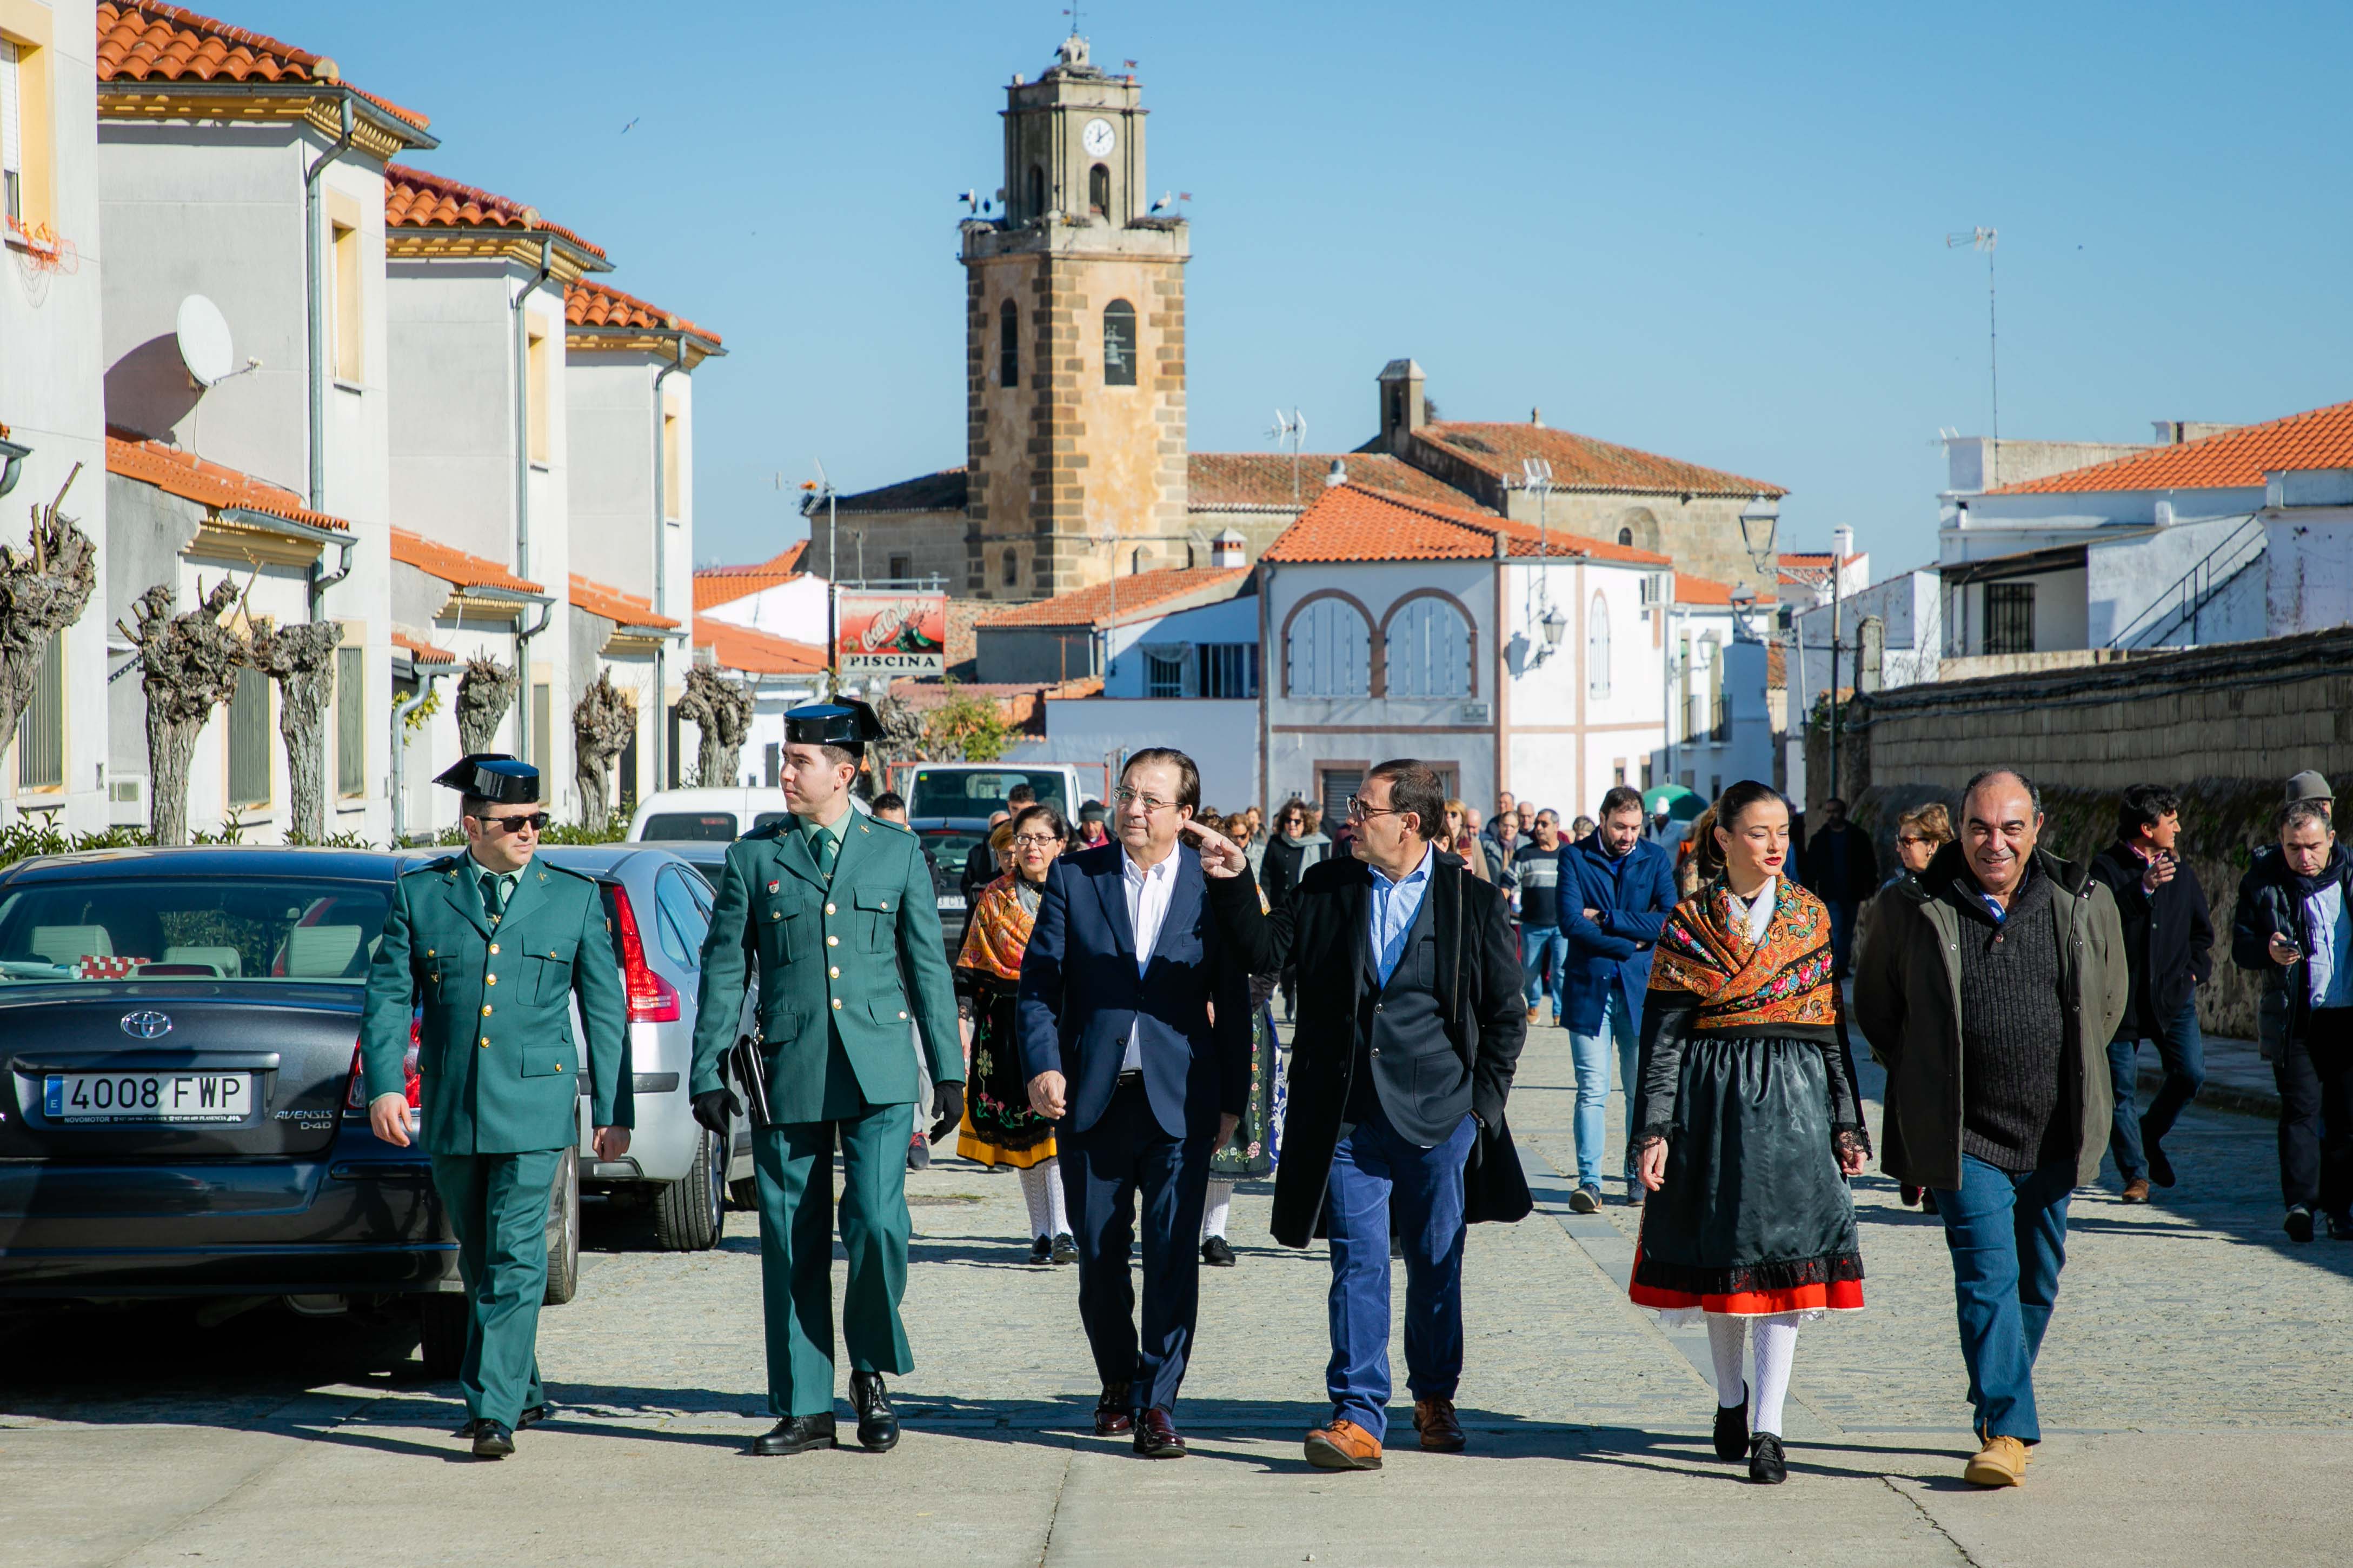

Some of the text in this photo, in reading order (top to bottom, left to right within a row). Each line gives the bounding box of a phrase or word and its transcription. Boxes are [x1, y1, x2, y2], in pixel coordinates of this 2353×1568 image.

[850, 656, 936, 666] PISCINA
[71, 1077, 240, 1109] 4008 FWP
[51, 1100, 57, 1108] E
[274, 1110, 333, 1119] AVENSIS
[301, 1122, 331, 1130] D-4D
